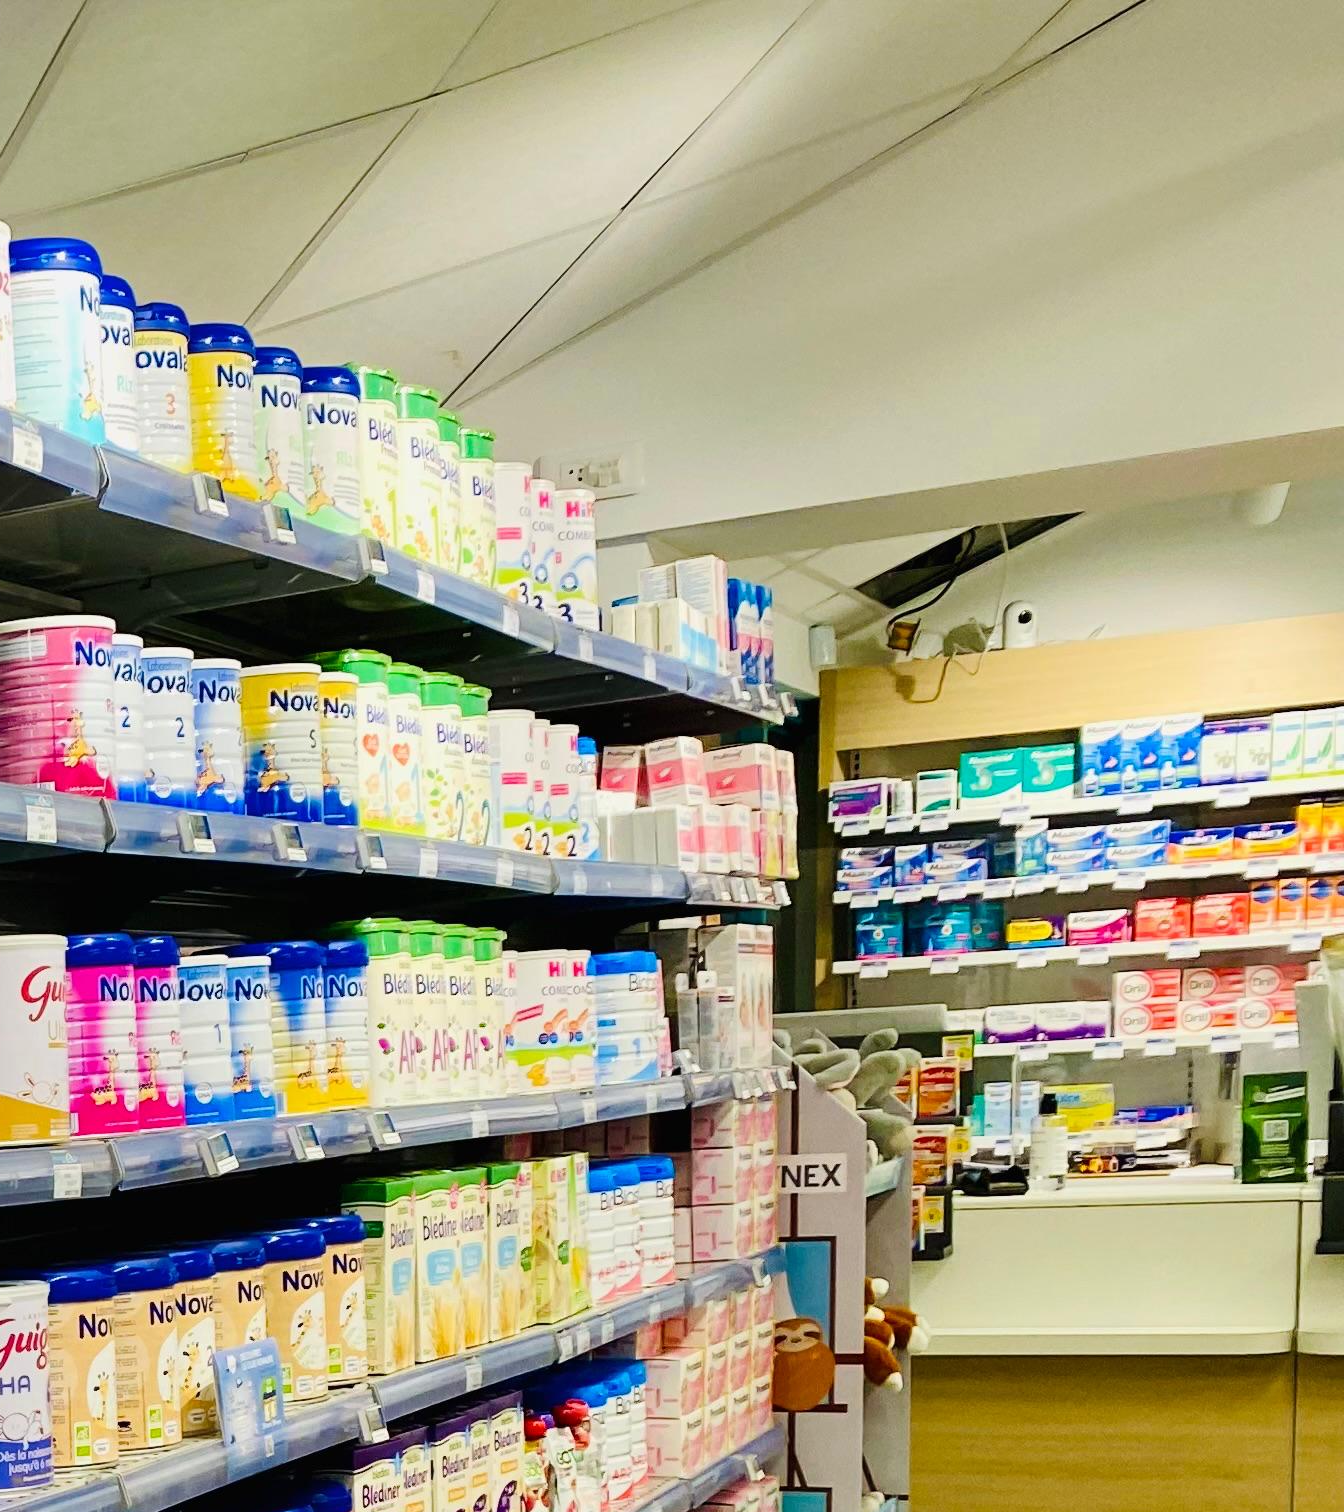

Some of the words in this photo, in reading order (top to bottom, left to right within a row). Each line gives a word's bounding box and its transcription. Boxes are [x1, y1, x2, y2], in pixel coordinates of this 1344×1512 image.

[1190, 980, 1211, 990] Drill
[1253, 977, 1276, 987] Drill
[1124, 984, 1146, 993] Drill
[1244, 1009, 1267, 1019] Drill
[1124, 1015, 1146, 1025] Drill
[777, 1164, 841, 1188] NEX
[423, 1214, 457, 1242] Blédine
[0, 1375, 31, 1396] HA
